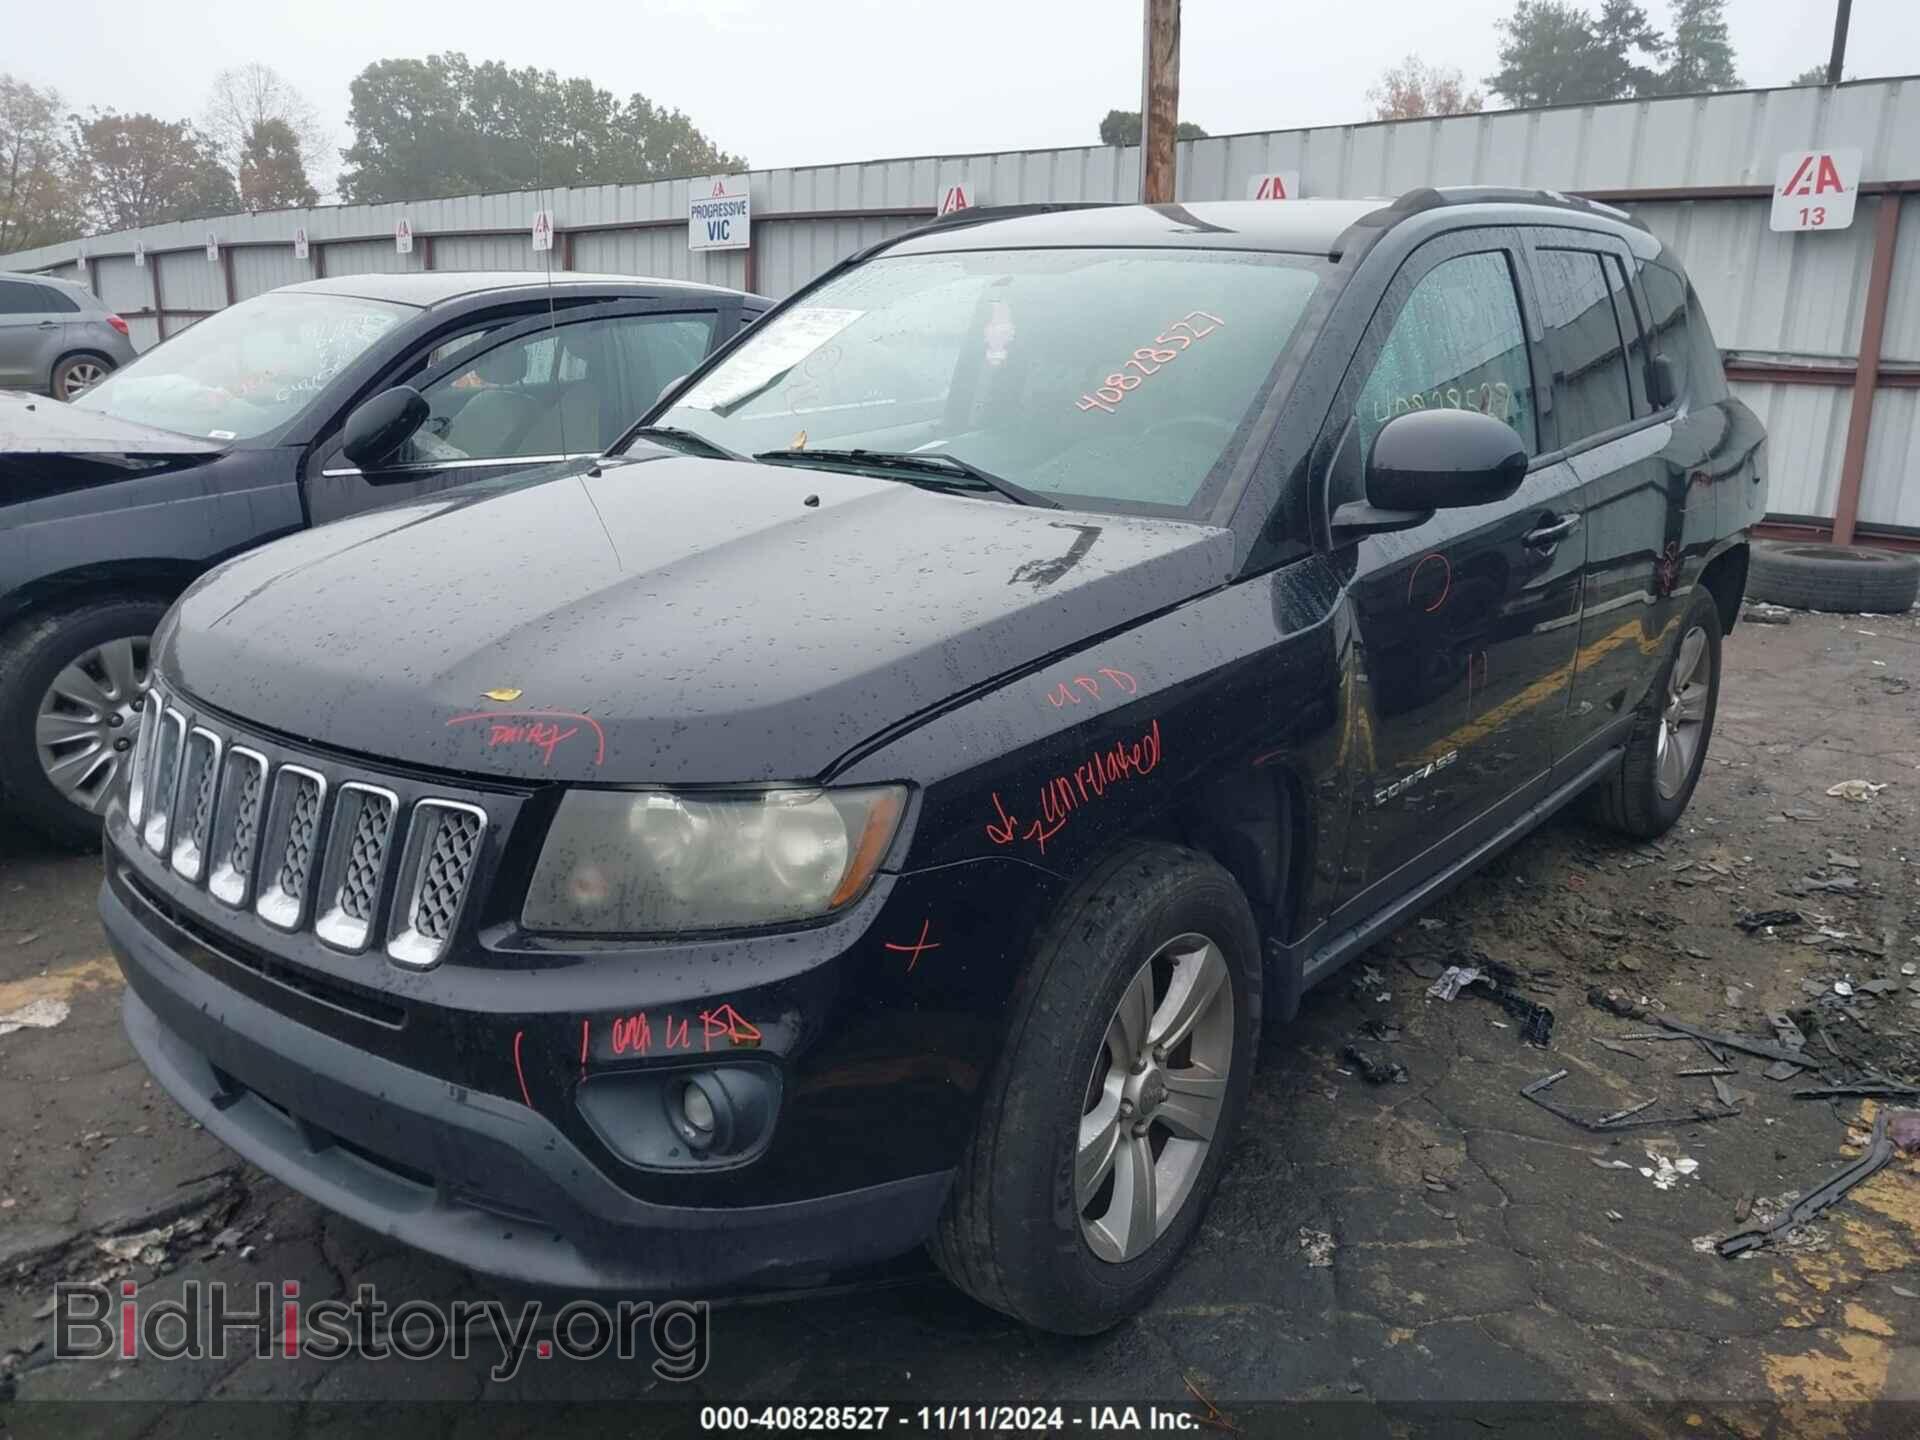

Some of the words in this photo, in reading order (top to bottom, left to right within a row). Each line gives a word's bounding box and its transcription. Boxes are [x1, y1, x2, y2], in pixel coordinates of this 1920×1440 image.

[691, 200, 746, 219] PROGRESSIVE
[1799, 206, 1826, 226] 13
[707, 219, 730, 241] VIC
[1074, 310, 1225, 414] 40828527
